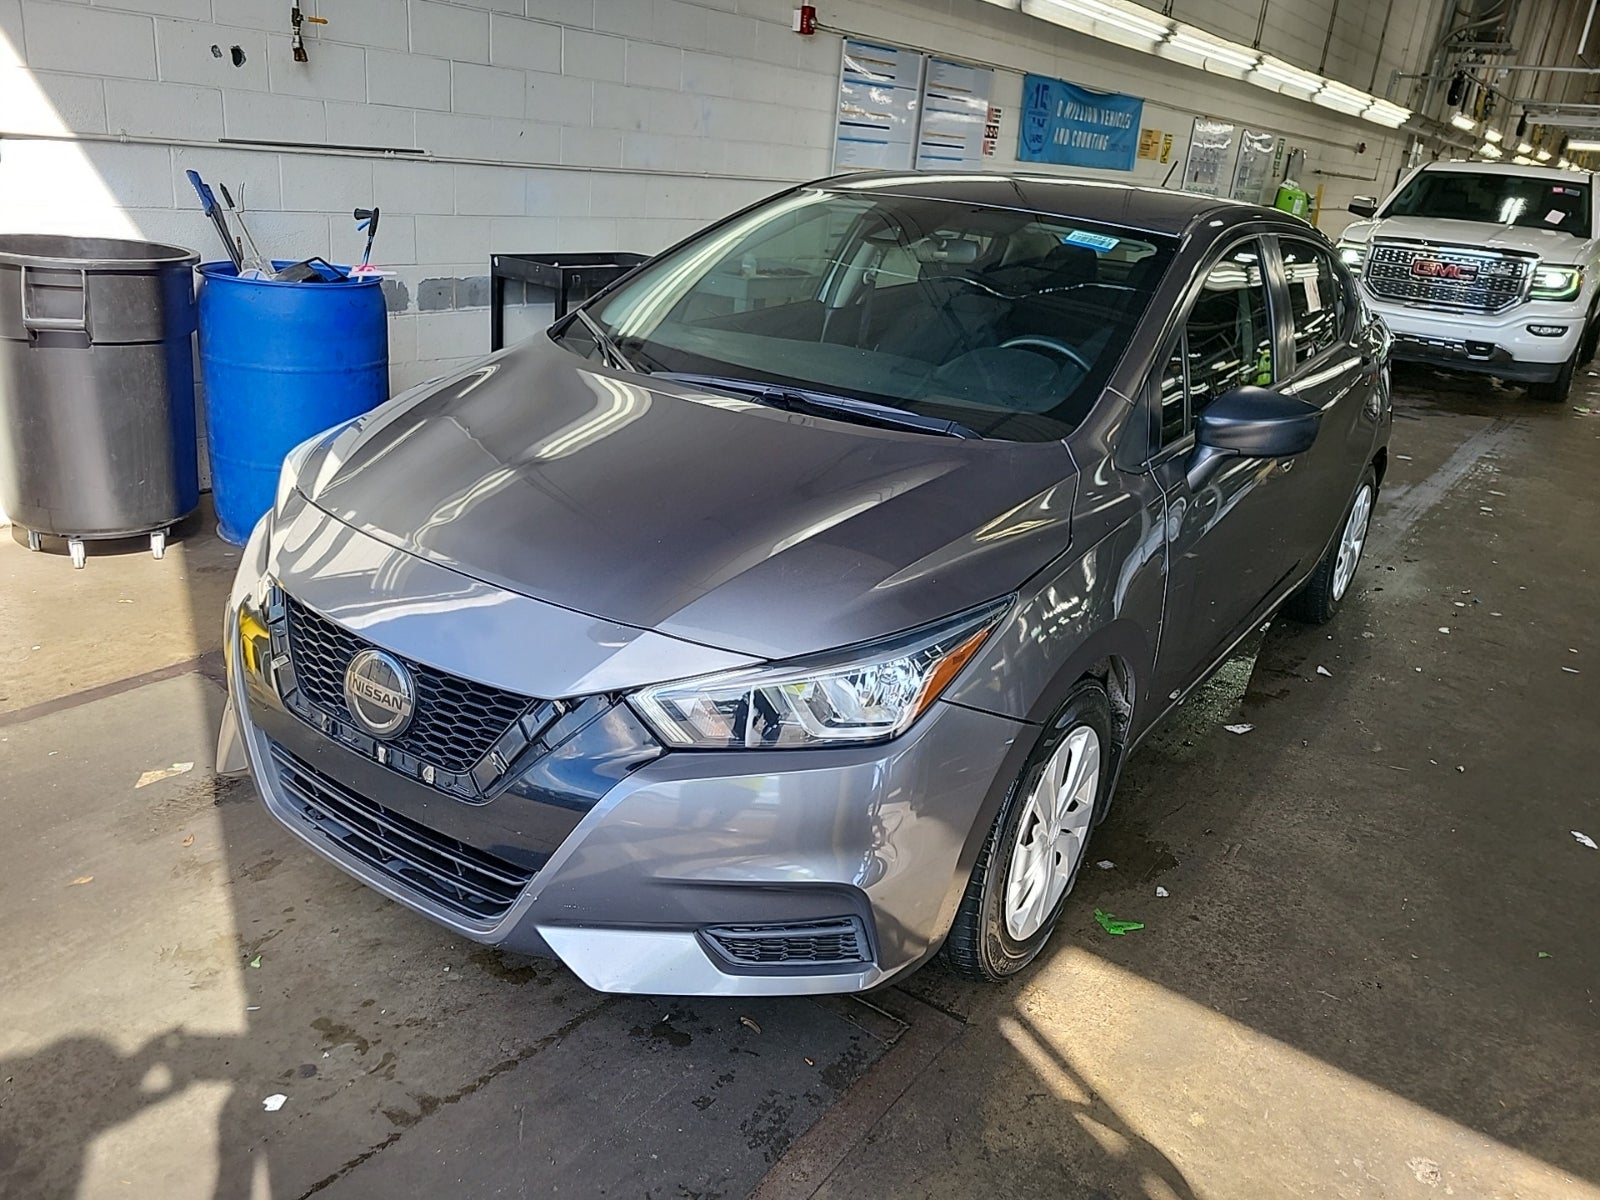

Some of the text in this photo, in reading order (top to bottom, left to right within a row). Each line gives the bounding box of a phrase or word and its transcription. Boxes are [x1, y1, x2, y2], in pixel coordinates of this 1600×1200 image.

[1053, 127, 1070, 146] AND
[1071, 129, 1110, 151] COUNTING
[1413, 260, 1477, 281] GMC
[352, 678, 403, 711] NISSAN
